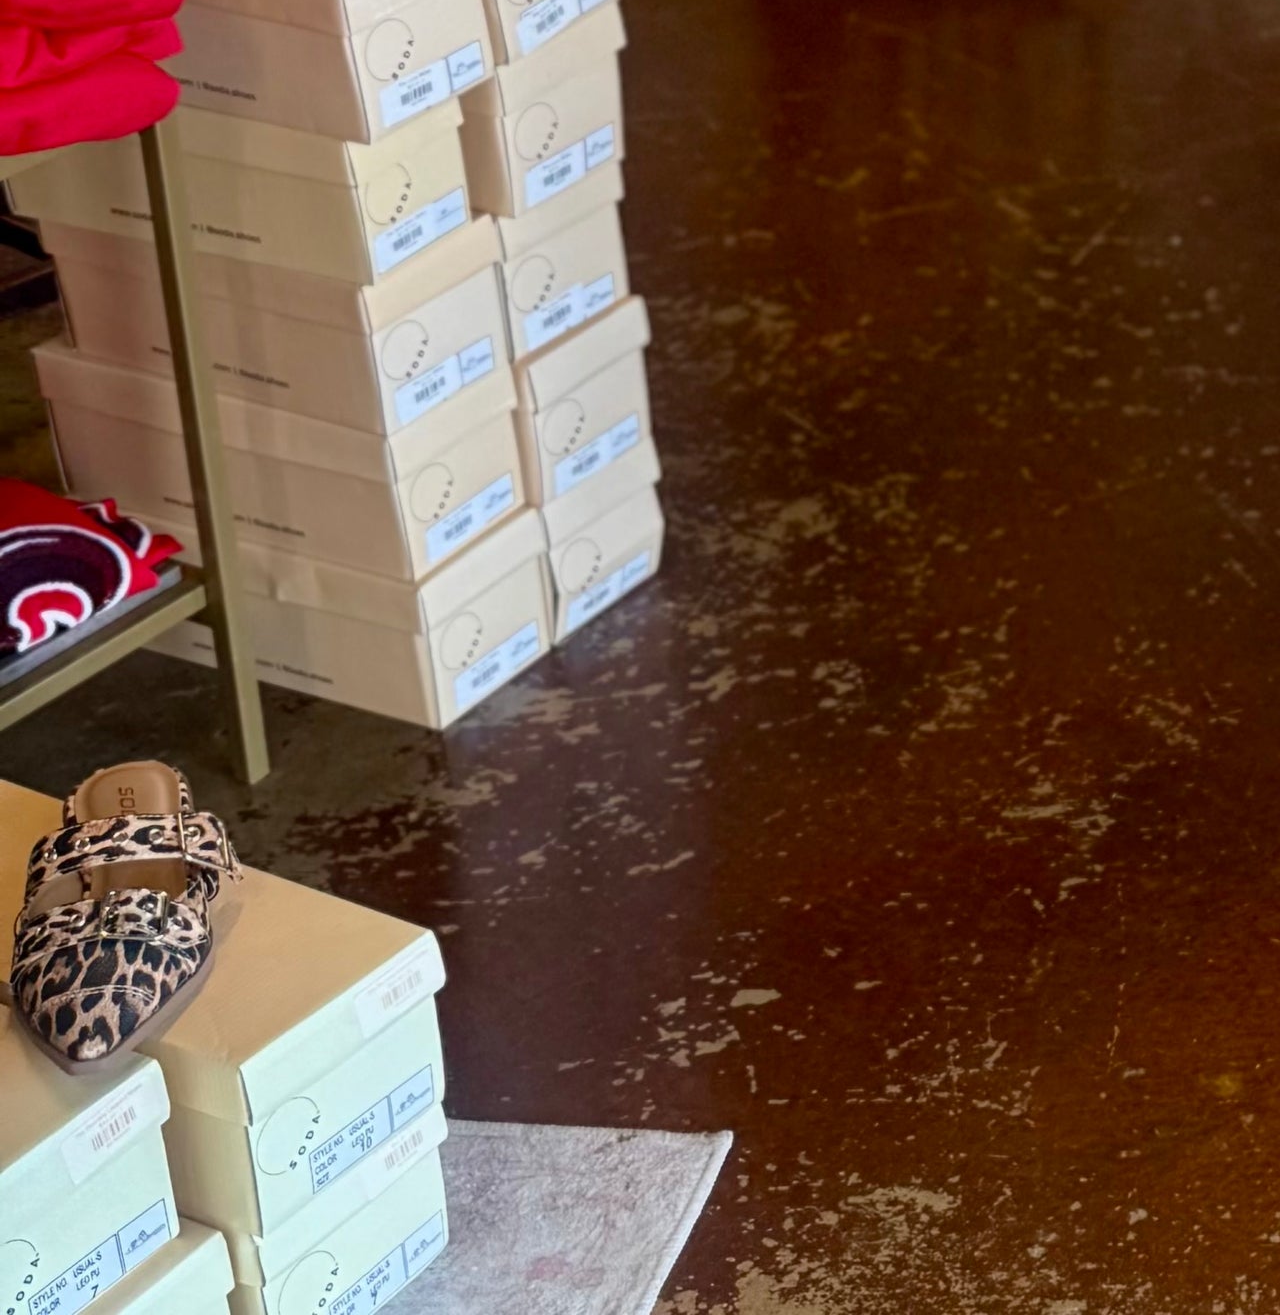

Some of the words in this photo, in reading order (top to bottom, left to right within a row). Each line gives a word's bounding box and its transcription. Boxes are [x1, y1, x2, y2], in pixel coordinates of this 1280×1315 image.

[391, 39, 414, 81] SODA
[536, 122, 559, 160] SODA
[390, 182, 412, 224] SODA
[533, 273, 555, 311] SODA
[405, 338, 429, 379] SODA
[289, 1114, 322, 1171] SODA
[32, 1286, 56, 1309] STYLE
[313, 1267, 340, 1315] ODA
